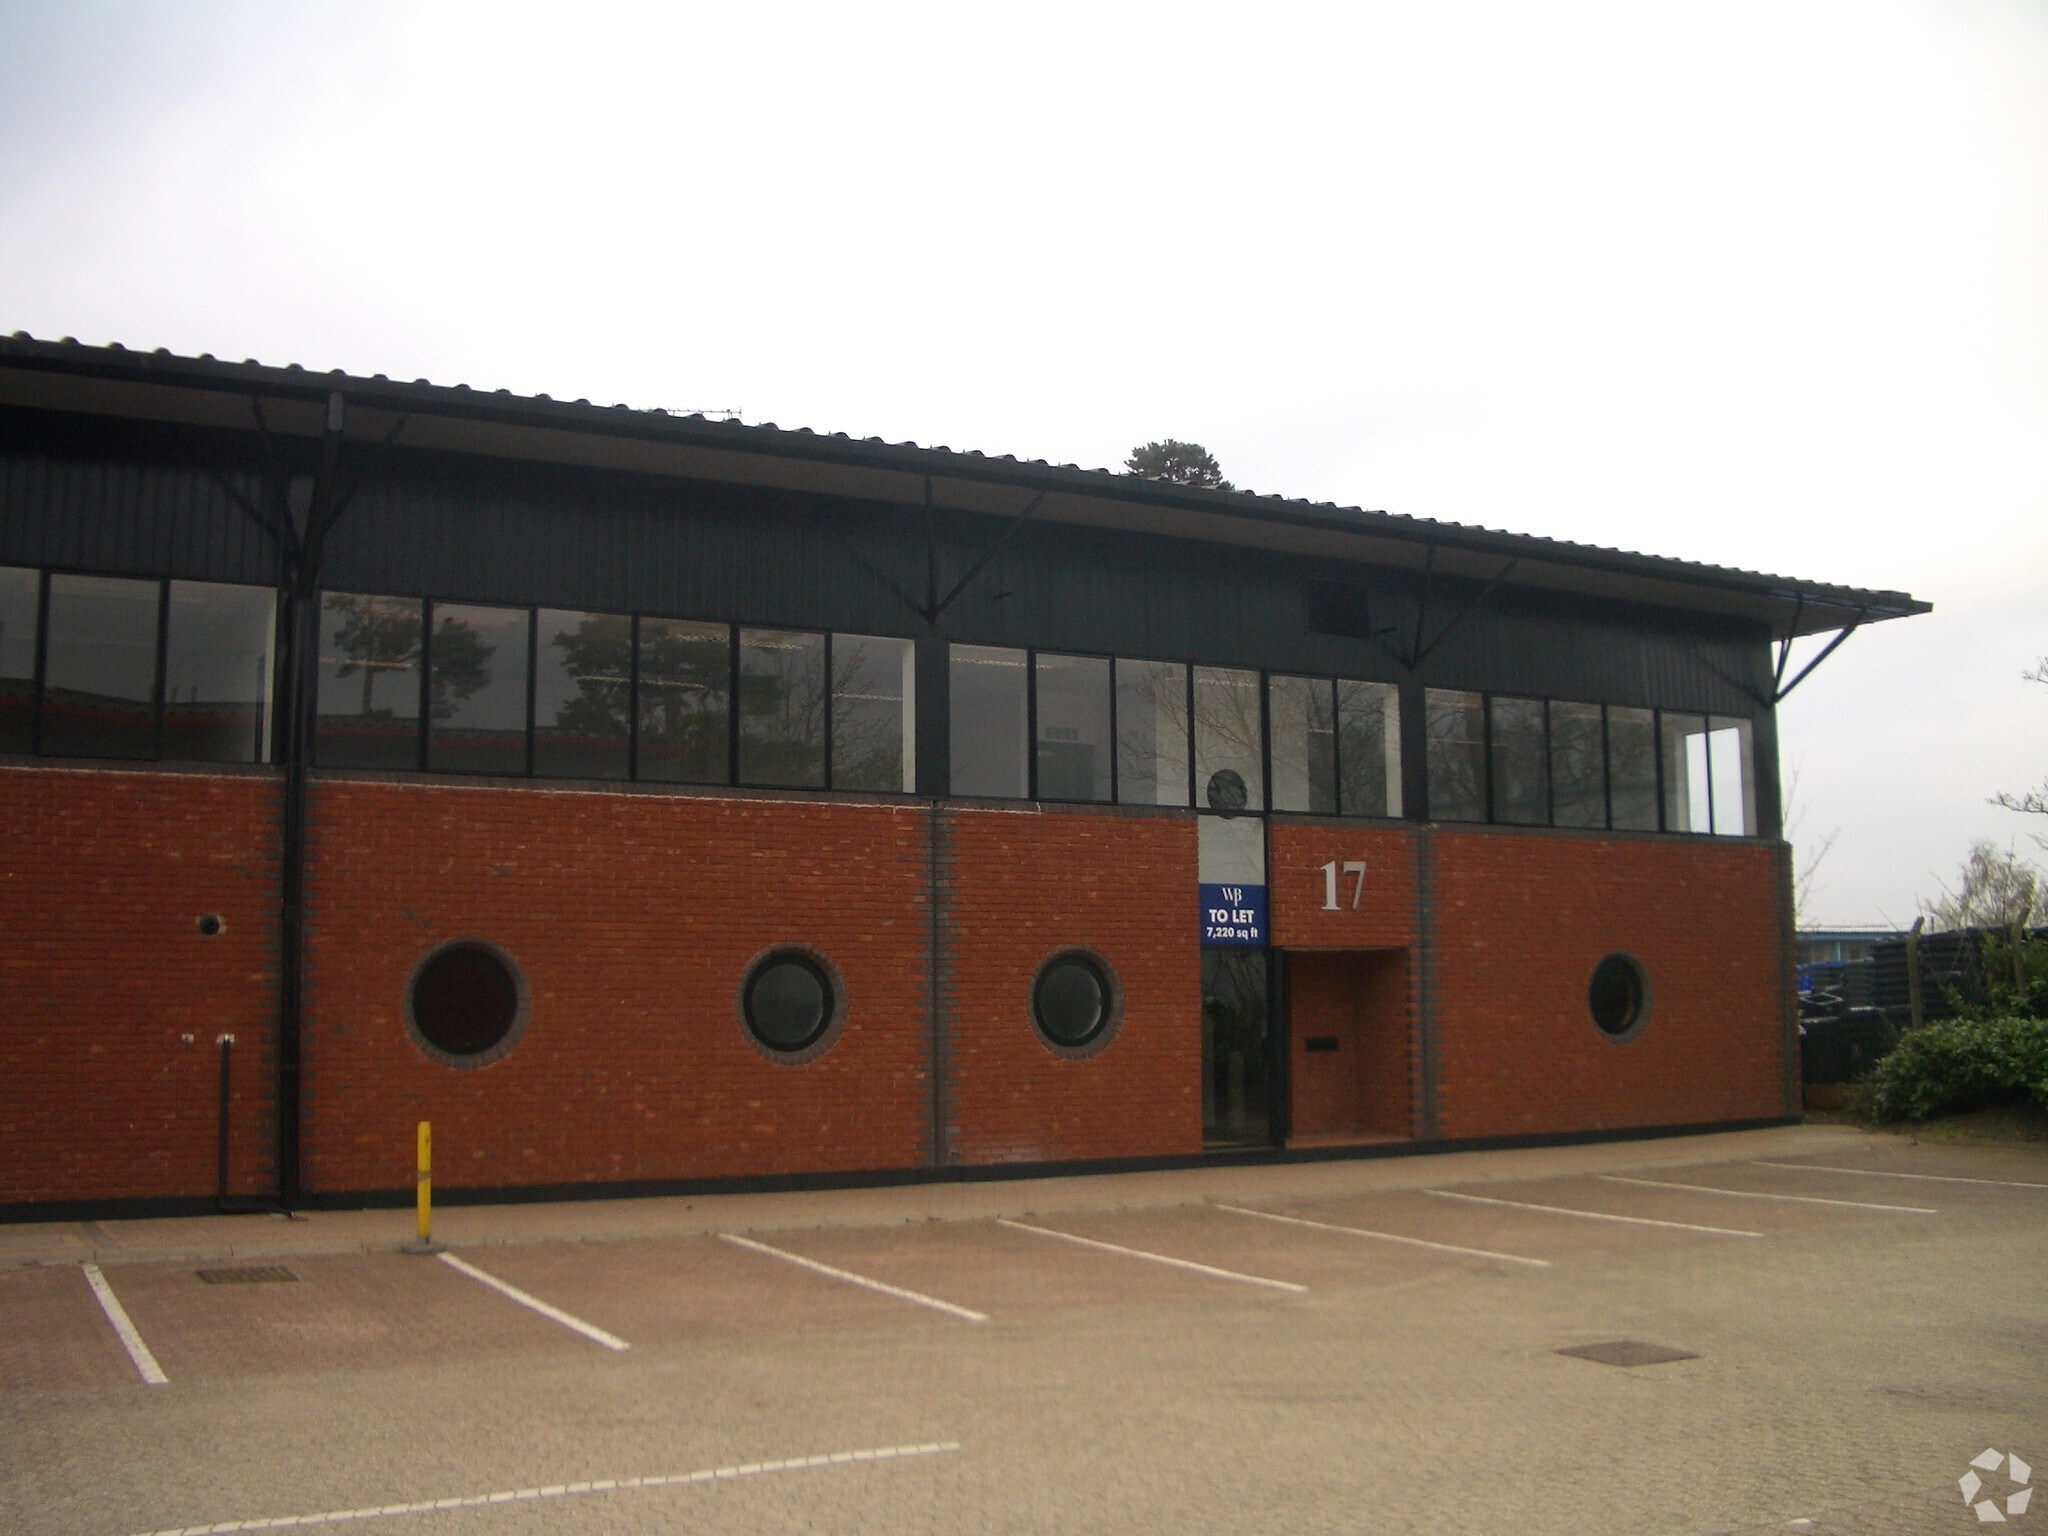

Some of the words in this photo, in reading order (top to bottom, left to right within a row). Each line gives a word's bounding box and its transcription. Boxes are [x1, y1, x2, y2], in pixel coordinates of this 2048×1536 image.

[1320, 860, 1367, 911] 17
[1208, 909, 1228, 923] TO
[1232, 909, 1254, 923] LET
[1206, 926, 1235, 939] 7,220
[1236, 929, 1249, 940] sq
[1250, 926, 1258, 938] ft
